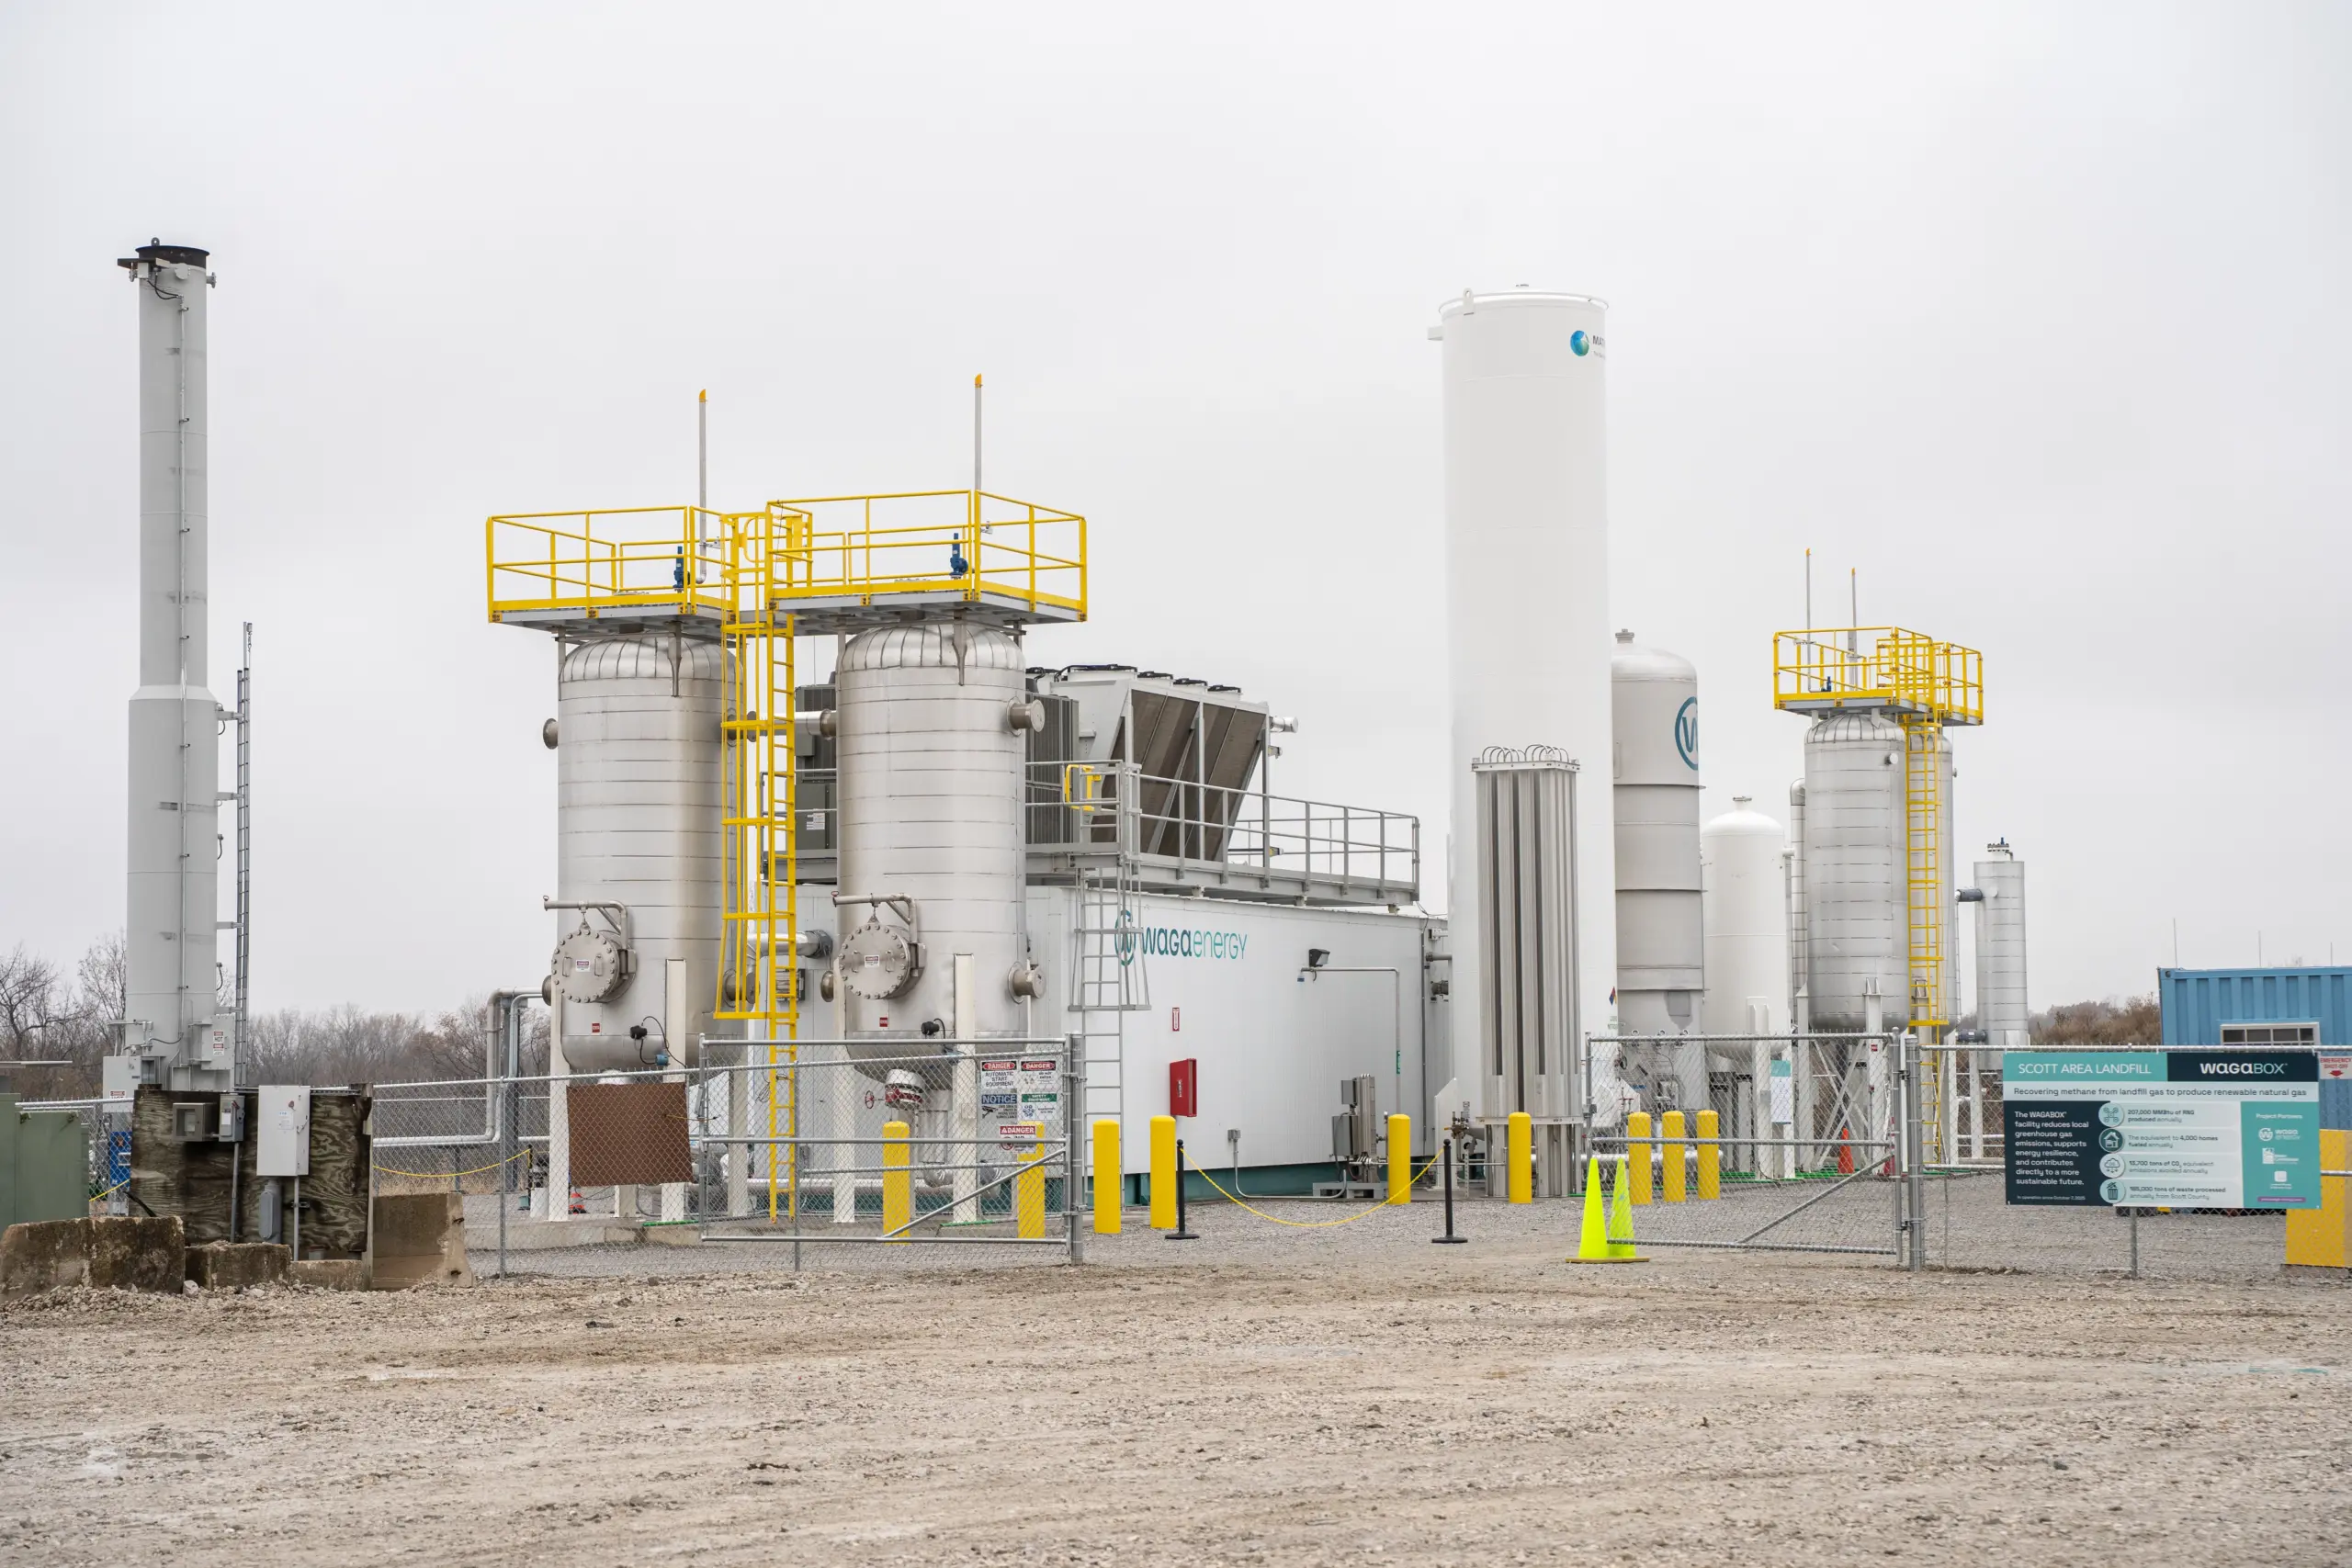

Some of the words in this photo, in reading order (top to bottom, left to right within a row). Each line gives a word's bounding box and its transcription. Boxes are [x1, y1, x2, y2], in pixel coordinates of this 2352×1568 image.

[2018, 1063, 2058, 1074] SCOTT
[2061, 1063, 2093, 1074] AREA
[2096, 1063, 2151, 1074] LANDFILL
[2177, 1089, 2212, 1097] produce
